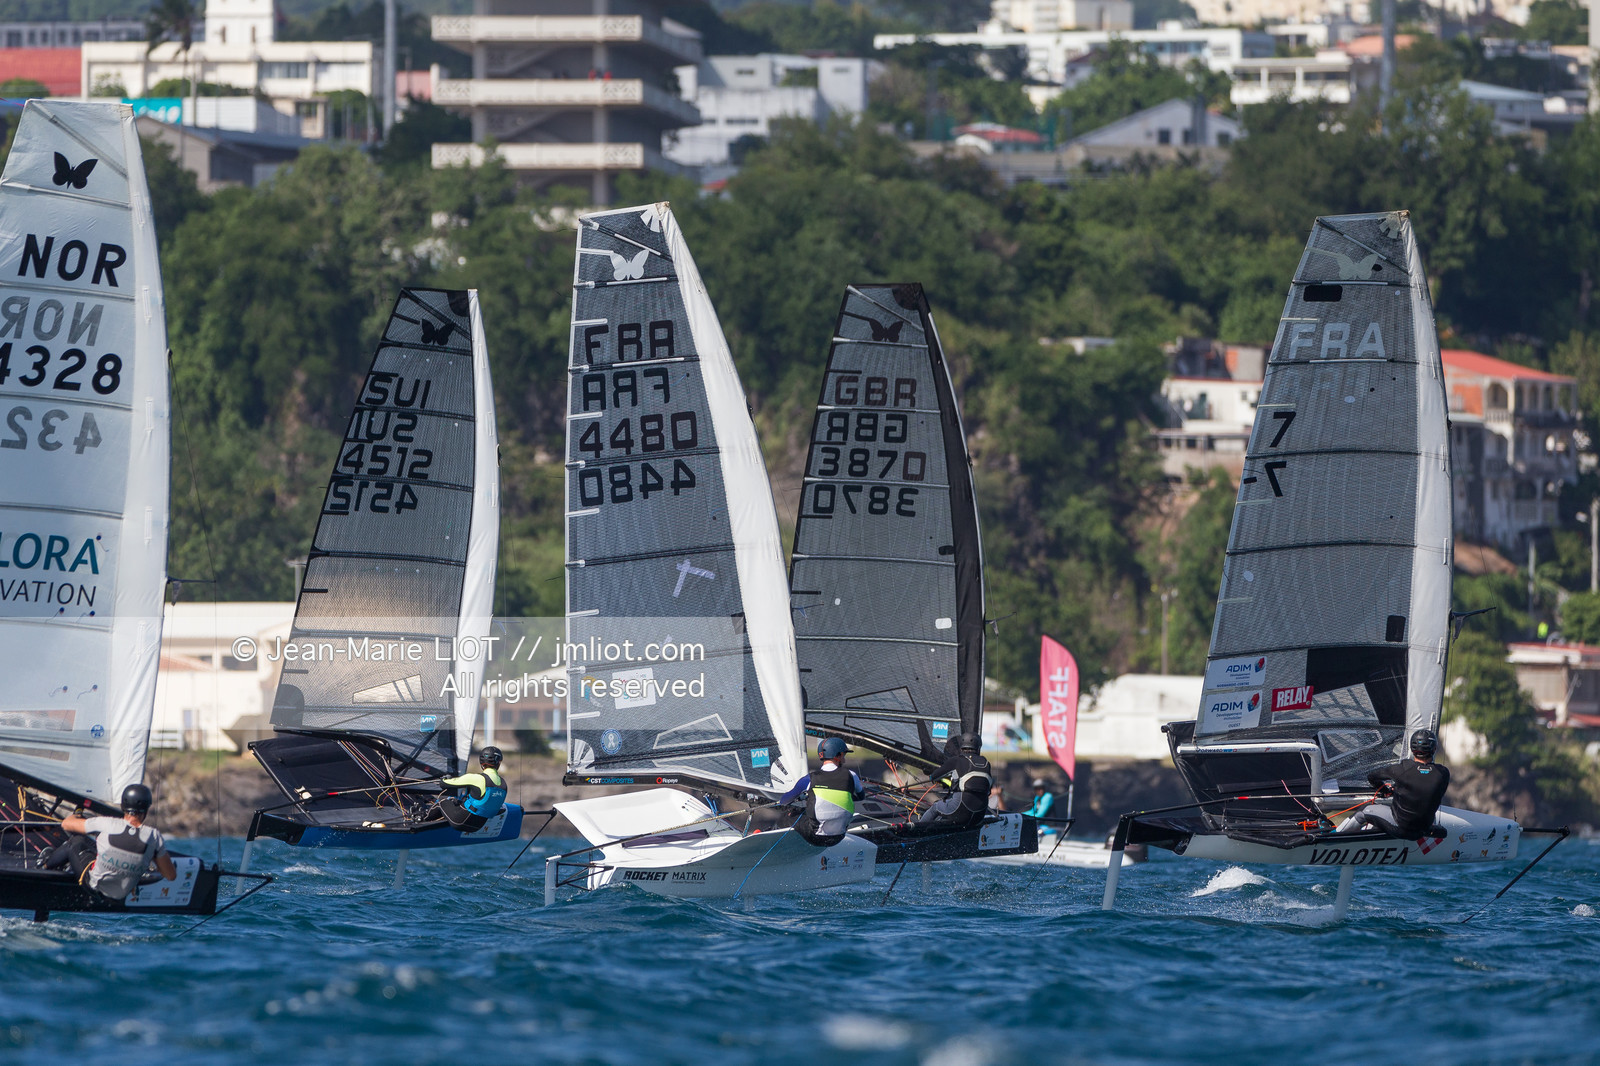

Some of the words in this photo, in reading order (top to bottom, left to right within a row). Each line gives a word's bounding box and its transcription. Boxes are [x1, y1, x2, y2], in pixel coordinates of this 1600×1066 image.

[18, 233, 127, 287] NOR
[584, 320, 675, 364] FRA
[1288, 322, 1386, 359] FRA
[365, 376, 431, 409] SUI
[835, 376, 917, 408] GBR
[579, 411, 698, 458] 4480
[1270, 411, 1296, 447] 7
[342, 444, 433, 479] 4512
[818, 447, 926, 481] 3870
[0, 579, 97, 607] VATION
[1225, 664, 1252, 673] ADIM
[1211, 701, 1243, 712] ADIM
[1276, 686, 1311, 709] RELAY
[622, 870, 669, 881] ROCKET
[671, 871, 707, 881] MATRIX
